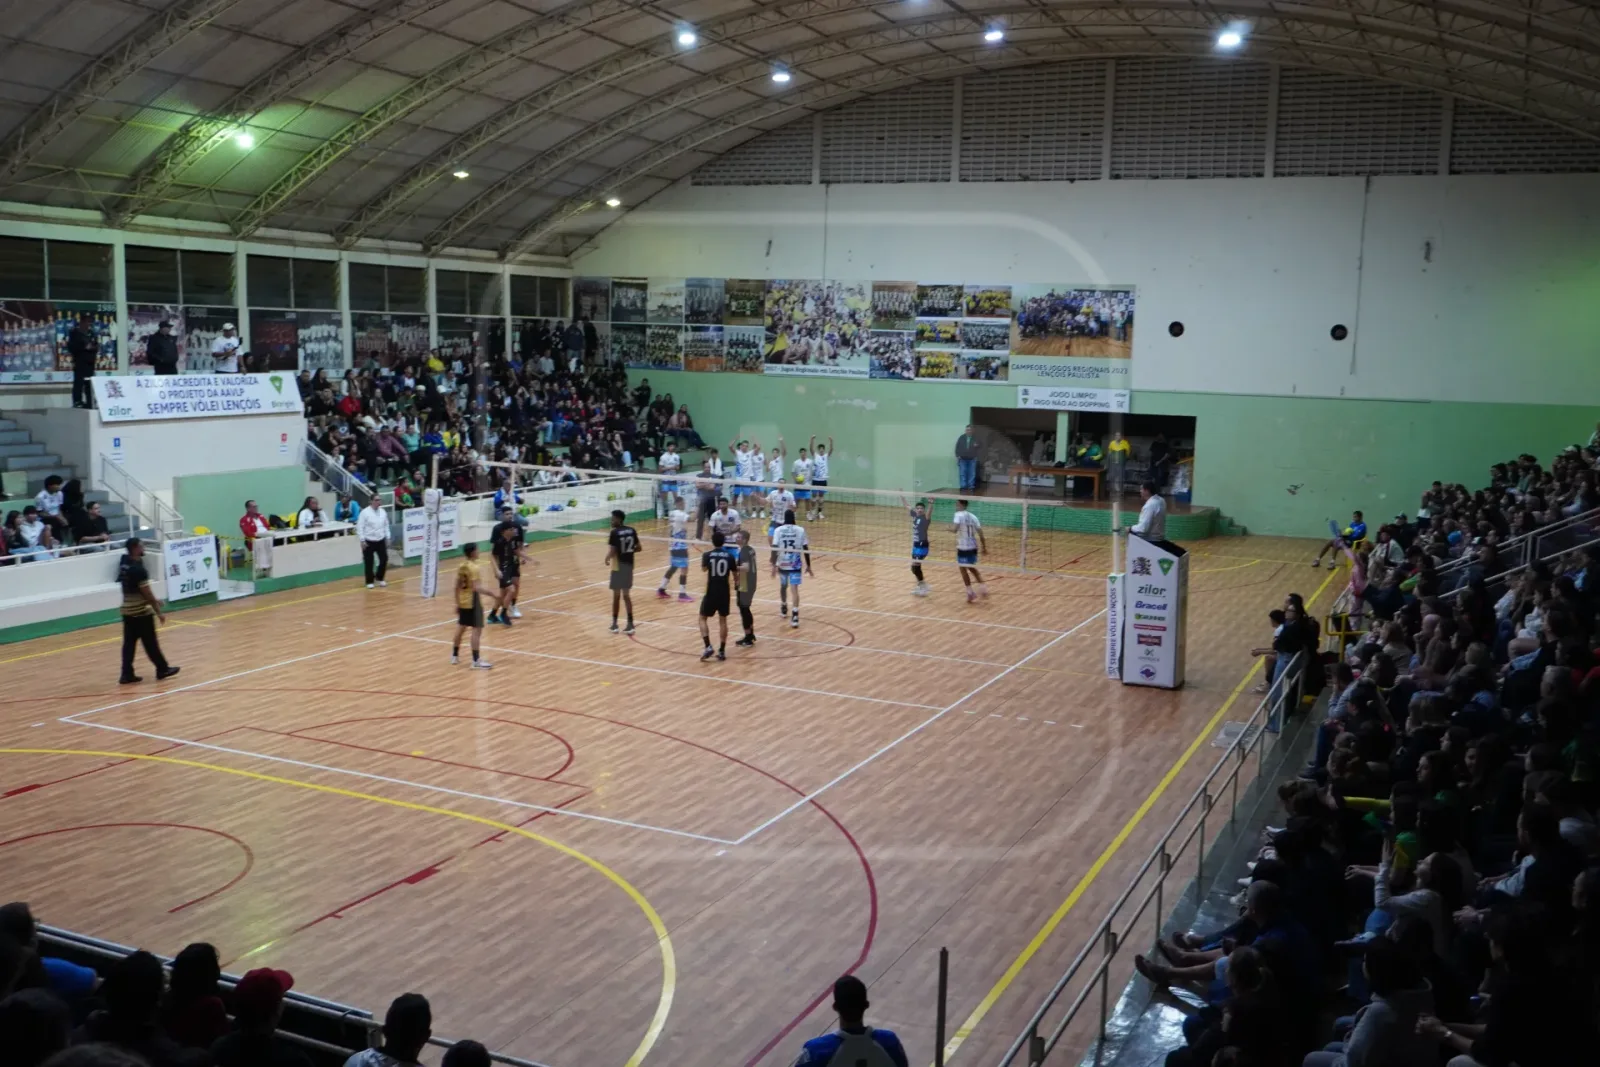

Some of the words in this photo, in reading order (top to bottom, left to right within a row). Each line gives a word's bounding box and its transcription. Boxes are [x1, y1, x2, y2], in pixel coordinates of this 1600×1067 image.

[1049, 364, 1071, 372] JOGOS
[1072, 365, 1110, 374] REGIONAIS
[1067, 371, 1100, 379] PAULISTA
[136, 379, 143, 388] A
[172, 376, 212, 387] ACREDITA
[214, 377, 219, 386] E
[221, 375, 259, 386] VALORIZA
[159, 390, 166, 399] O
[168, 389, 205, 399] PROJETO
[208, 388, 219, 398] DA
[221, 388, 245, 397] AAVLP
[108, 404, 133, 416] zilor
[147, 402, 189, 414] SEMPRE
[221, 397, 262, 412] LENÇÓIS
[1080, 401, 1110, 409] DOPPING
[619, 535, 635, 553] 12
[782, 539, 796, 554] 13
[709, 558, 728, 577] 10
[180, 578, 208, 593] zilor
[1137, 584, 1167, 595] zilor
[1135, 600, 1168, 611] Bracell
